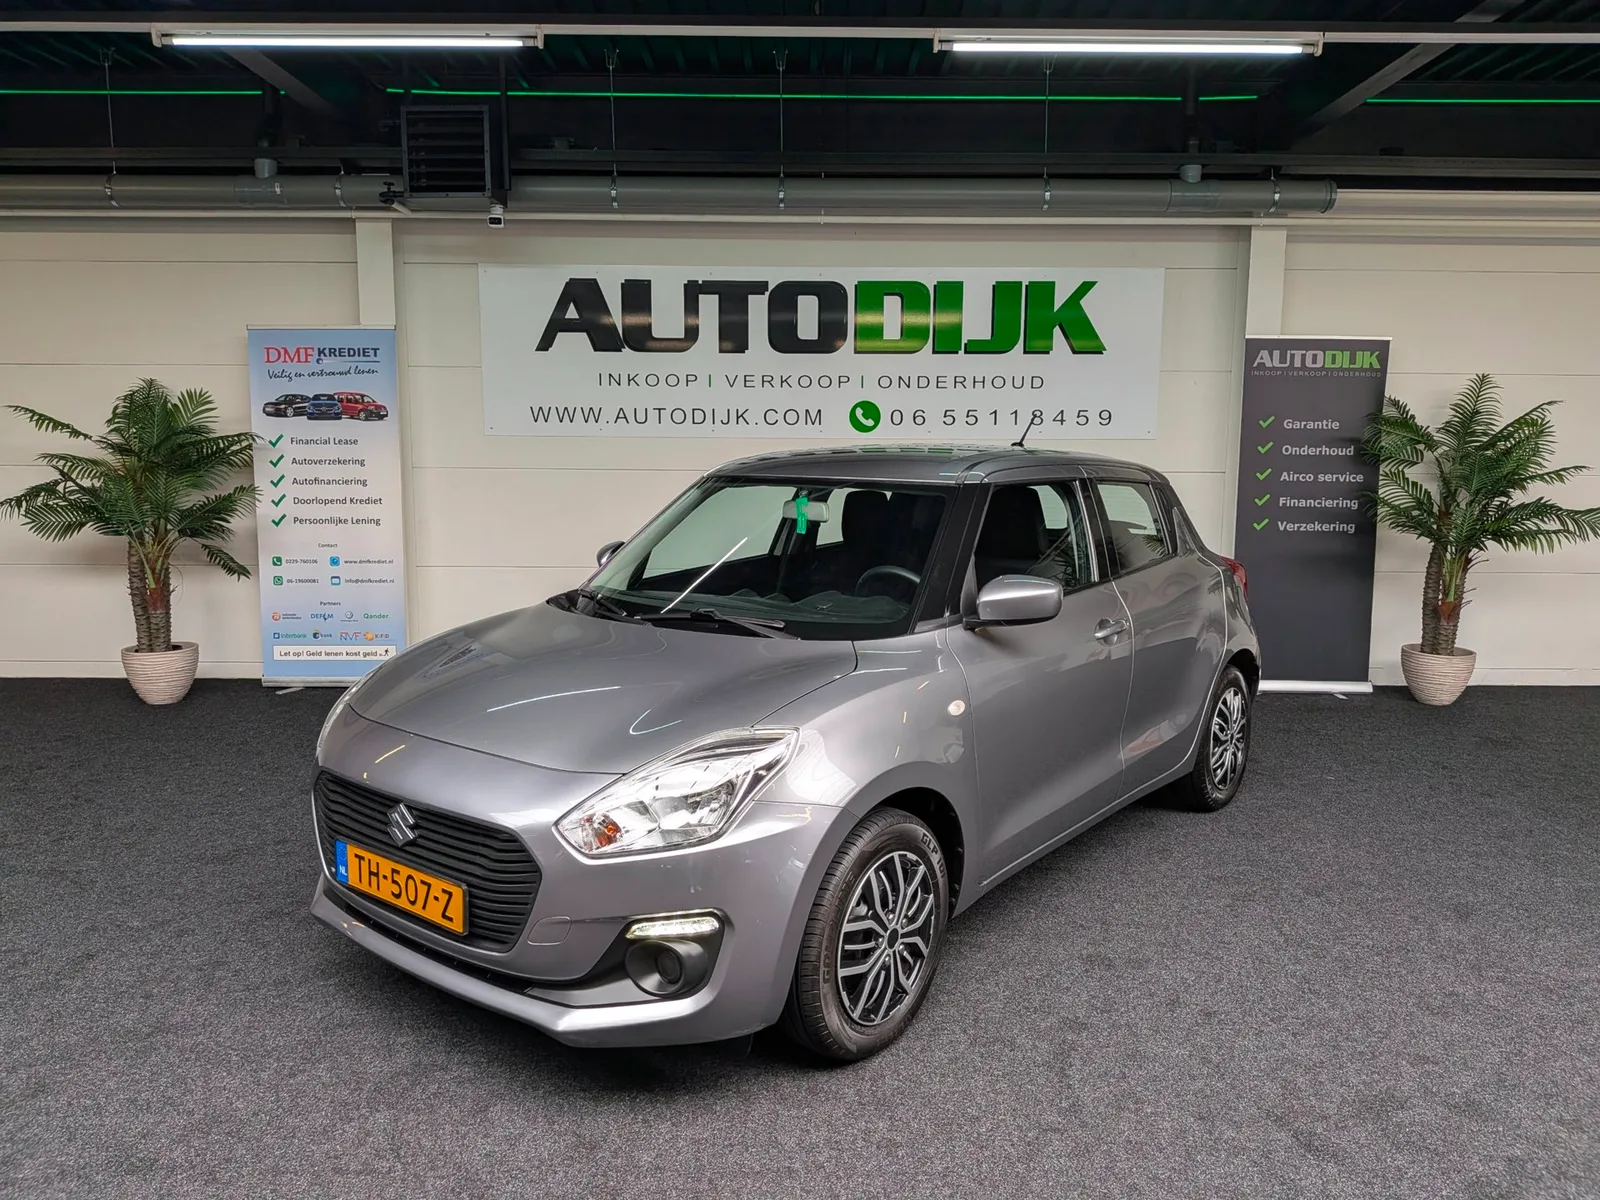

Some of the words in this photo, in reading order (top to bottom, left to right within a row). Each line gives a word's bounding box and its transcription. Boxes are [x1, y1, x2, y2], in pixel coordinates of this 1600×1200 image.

[534, 278, 1107, 354] AUTODIJK
[264, 347, 315, 364] DMF
[317, 347, 380, 358] KREDIET
[1252, 350, 1381, 368] AUTODIJK
[268, 369, 293, 382] Veilig
[307, 366, 352, 377] vertrouwd
[354, 365, 379, 375] lenen
[598, 373, 698, 388] INKOOP
[724, 374, 850, 389] VERKOOP
[877, 375, 1045, 390] ONDERHOUD
[529, 406, 823, 426] WWW.AUTODIJK.COM
[1283, 419, 1340, 430] Garantie
[290, 437, 331, 446] Financial
[333, 437, 359, 446] Lease
[1282, 445, 1354, 456] Onderhoud
[291, 457, 366, 467] Autoverzekering
[292, 477, 368, 487] Autofinanciering
[1280, 471, 1314, 482] Airco
[1317, 472, 1364, 482] service
[293, 496, 346, 507] Doorlopend
[349, 497, 383, 506] Krediet
[1279, 497, 1359, 510] Financiering
[293, 517, 349, 527] Persoonlijke
[351, 517, 381, 527] Lening
[1277, 521, 1356, 534] Verzekering
[292, 650, 304, 658] op!
[362, 650, 378, 658] geld
[354, 853, 454, 924] TH-507-Z
